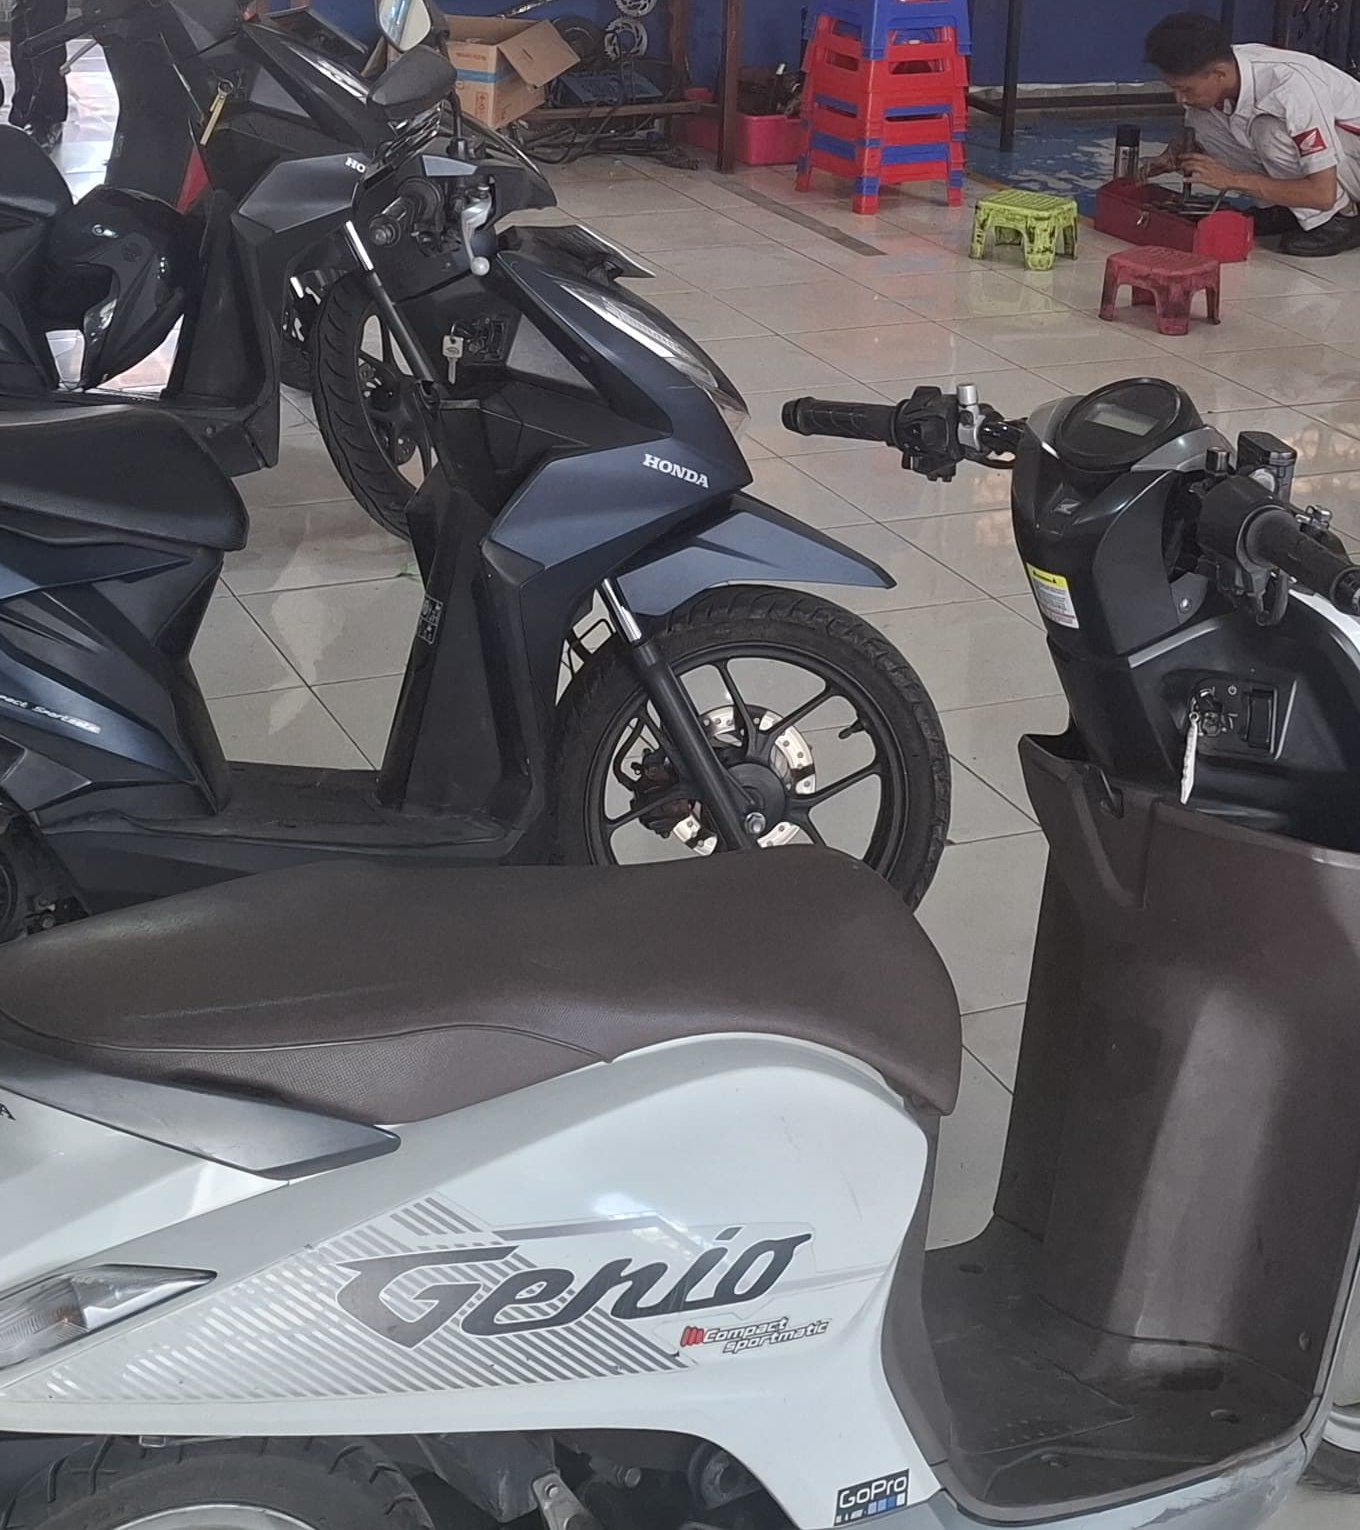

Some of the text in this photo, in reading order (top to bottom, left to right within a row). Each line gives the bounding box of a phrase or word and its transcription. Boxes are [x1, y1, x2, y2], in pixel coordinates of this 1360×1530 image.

[642, 453, 709, 488] HONDA
[335, 1226, 814, 1350] Genio
[703, 1316, 789, 1345] Compact
[722, 1320, 831, 1354] sportmatic
[839, 1476, 908, 1509] GoPro
